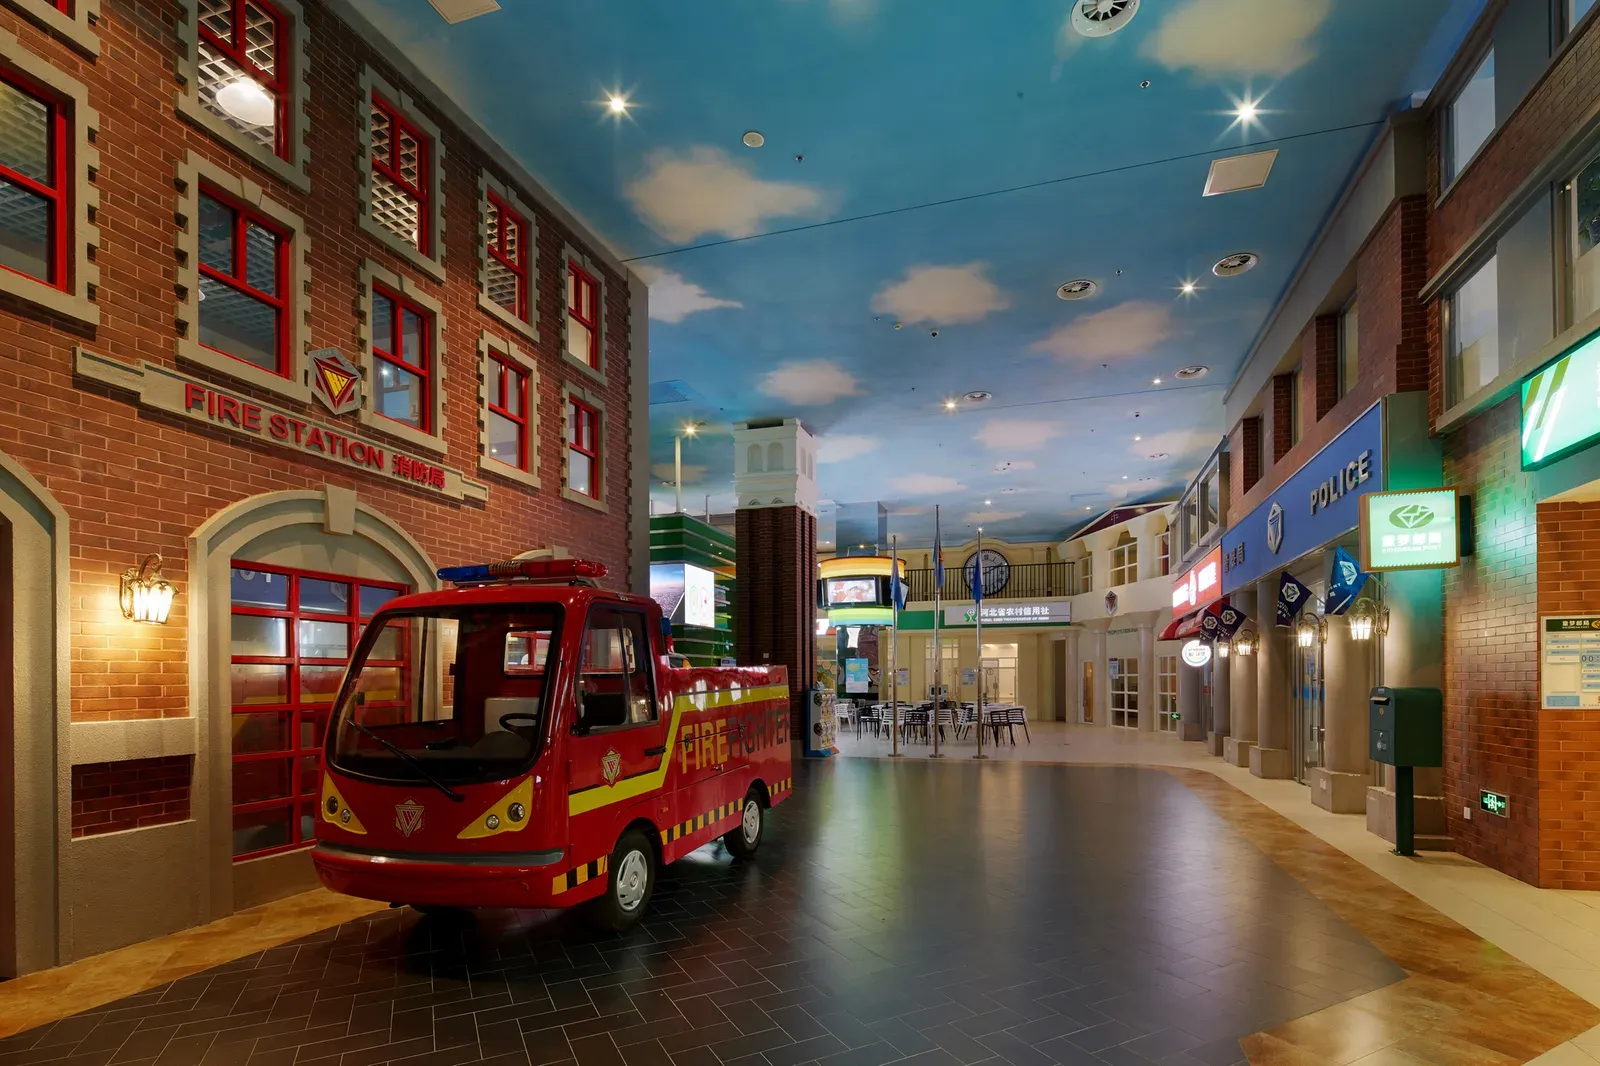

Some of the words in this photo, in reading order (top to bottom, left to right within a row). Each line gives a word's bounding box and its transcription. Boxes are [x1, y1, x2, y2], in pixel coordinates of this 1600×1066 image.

[184, 383, 262, 432] FIRE
[269, 413, 384, 470] STATION
[392, 453, 446, 489] 消防局
[1310, 449, 1372, 516] POLICE
[981, 606, 1050, 617] 河北省农村信用社
